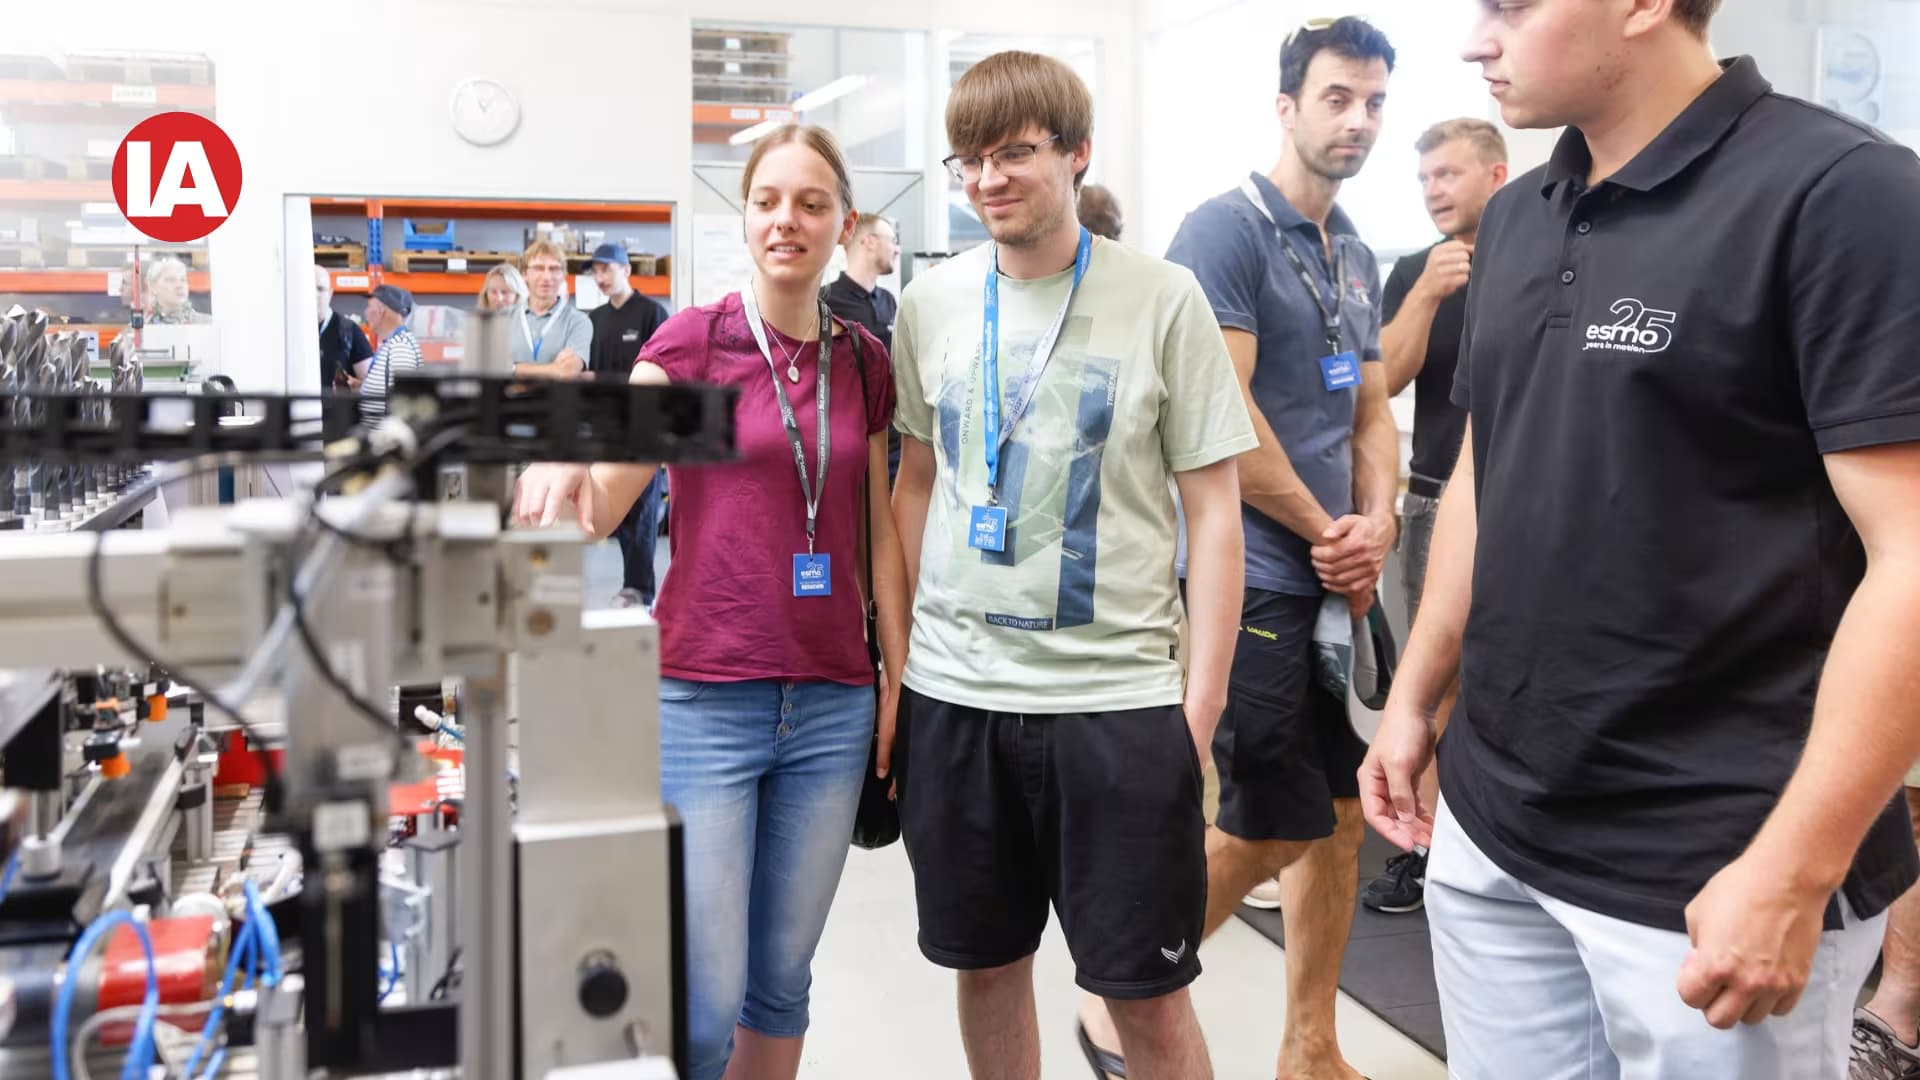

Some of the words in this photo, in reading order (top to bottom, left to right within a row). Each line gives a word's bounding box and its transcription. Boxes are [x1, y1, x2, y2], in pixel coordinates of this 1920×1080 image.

[1586, 324, 1658, 345] esmo
[1609, 298, 1676, 353] 25
[1582, 341, 1604, 351] years
[1605, 340, 1612, 349] in
[1613, 344, 1645, 354] motion
[961, 399, 973, 444] ONWARD
[988, 615, 1007, 625] BACK
[1008, 617, 1018, 627] TO
[1018, 619, 1049, 630] NATURE
